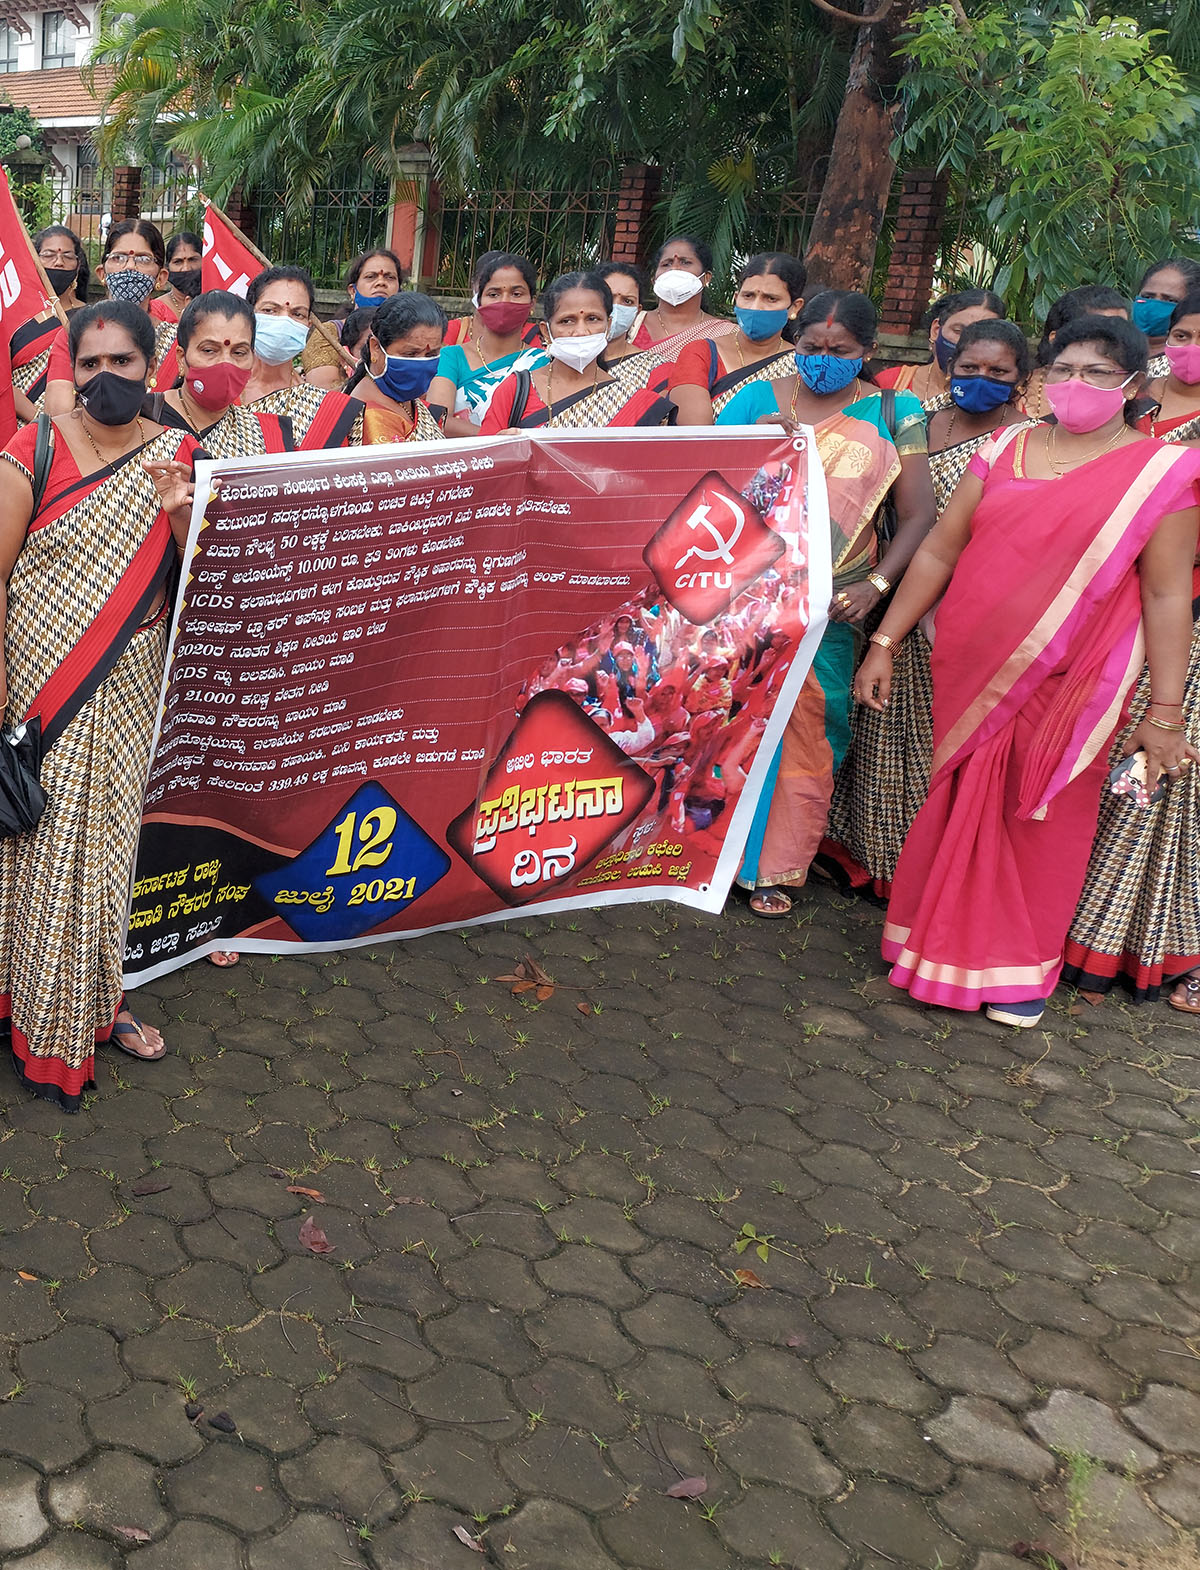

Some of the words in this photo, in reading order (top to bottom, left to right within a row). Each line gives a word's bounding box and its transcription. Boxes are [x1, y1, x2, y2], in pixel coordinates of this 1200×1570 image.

[283, 476, 330, 494] ಸಂದರ್ಭದ
[333, 472, 368, 492] ಕೆಲಸಕ್ಕೆ
[371, 469, 393, 487] ಎಲ್ಲಾ
[394, 466, 430, 482] ರೀತಿಯ
[470, 455, 494, 470] ಬೇಕು
[216, 510, 268, 531] ಕುಟುಂಬದ
[378, 494, 406, 510] ಉಚಿತ
[436, 485, 474, 502] ಸಿಗಬೇಕು
[206, 544, 240, 558] ವಿಮಾ
[244, 537, 276, 560] ಸೌಲಭ್ಯ
[280, 534, 298, 550] 50
[475, 502, 512, 519] ಕೂಡಲೇ
[364, 550, 382, 568] ಪ್ರತಿ
[190, 594, 234, 609] ICDS
[321, 582, 343, 596] ಈಗ
[674, 572, 732, 589] CITU
[369, 597, 393, 613] ಮತ್ತು
[176, 644, 226, 658] 2020ರ
[230, 644, 270, 658] ನೂತನ
[342, 626, 362, 641] ಜಾರಿ
[366, 620, 388, 636] ಬೇಡ
[172, 666, 208, 684] ICDS
[330, 652, 354, 666] ಮಾಡಿ
[274, 686, 305, 702] ವೇತನ
[308, 680, 330, 694] ನೀಡಿ
[322, 699, 347, 714] ಮಾಡಿ
[356, 708, 404, 728] ಮಾಡಬೇಕು
[212, 757, 277, 772] ಅಂಗನವಾಡಿ
[412, 728, 439, 744] ಮತ್ತು
[506, 752, 535, 773] ಅಖಿಲ
[541, 748, 594, 768] ಭಾರತ
[206, 775, 265, 792] ಸೇರಿದಂತೆ
[268, 772, 309, 792] 339.48
[372, 751, 412, 768] ಕೂಡಲೇ
[416, 749, 458, 763] ಬಿಡುಗಡೆ
[472, 776, 624, 855] ಪ್ರತಿಭಟನಾ
[326, 806, 397, 876] 12
[132, 862, 190, 899] ಕರ್ನಾಟಕ
[193, 858, 222, 886] ರಾಜ್ಯ
[510, 834, 578, 887] ದಿನ
[168, 886, 214, 920] ನೌಕರರ
[215, 881, 252, 904] ಸಂಘ
[274, 886, 335, 914] ಜುಲೈ
[347, 877, 417, 906] 2021
[150, 932, 180, 954] ಜಿಲ್ಲಾ
[185, 915, 223, 942] ಸಮಿತಿ
